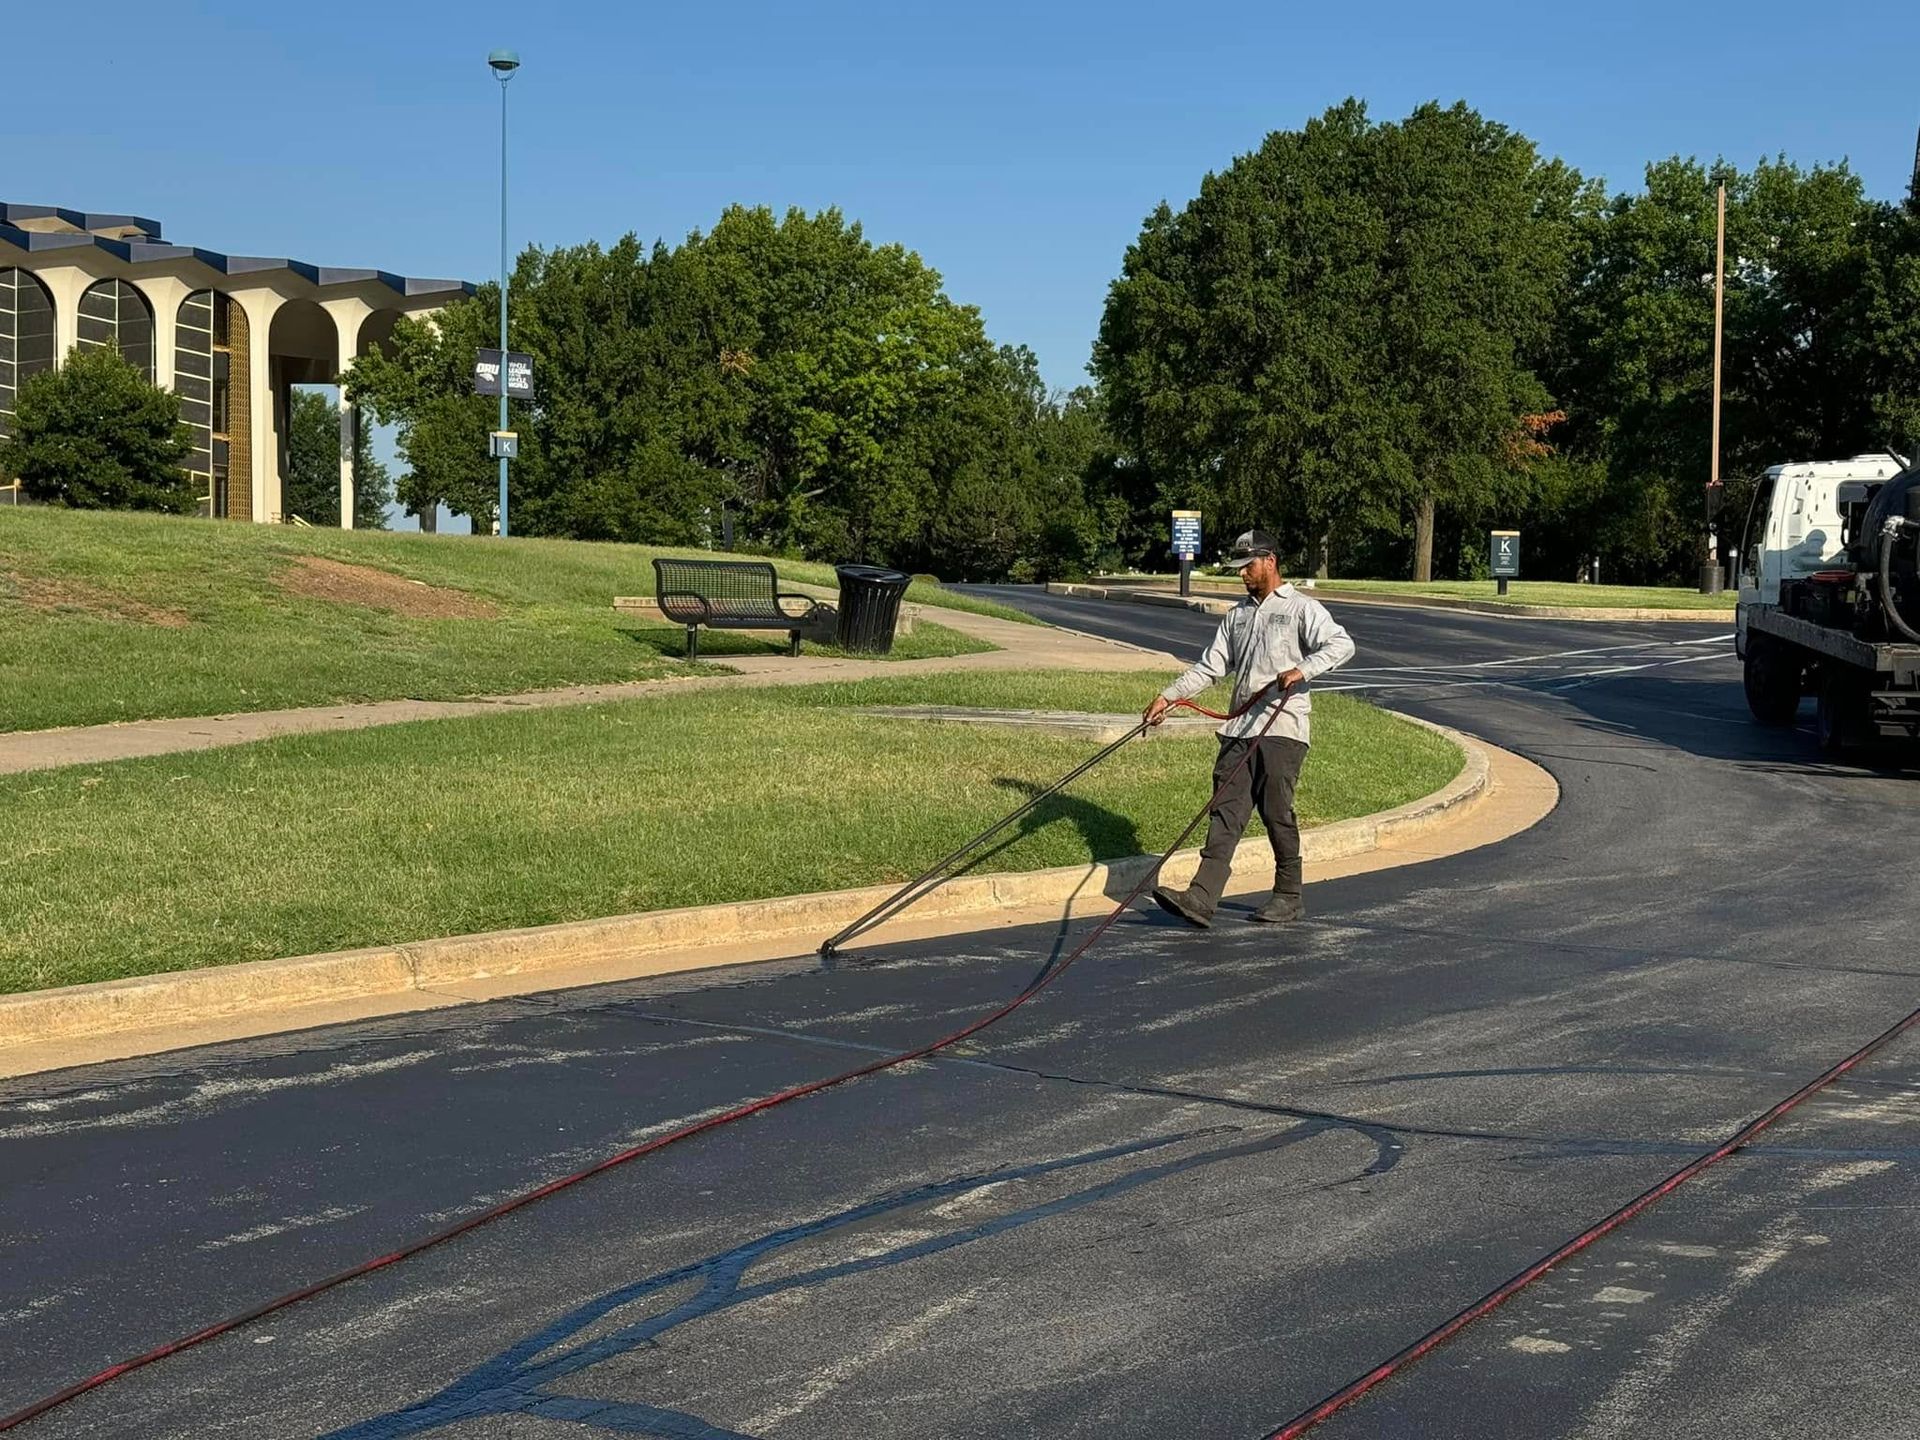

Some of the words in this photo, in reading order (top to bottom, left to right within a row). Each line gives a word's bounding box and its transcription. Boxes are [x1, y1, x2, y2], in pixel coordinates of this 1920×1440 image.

[476, 362, 500, 375] ORU
[503, 441, 511, 452] K
[1501, 540, 1511, 553] K
